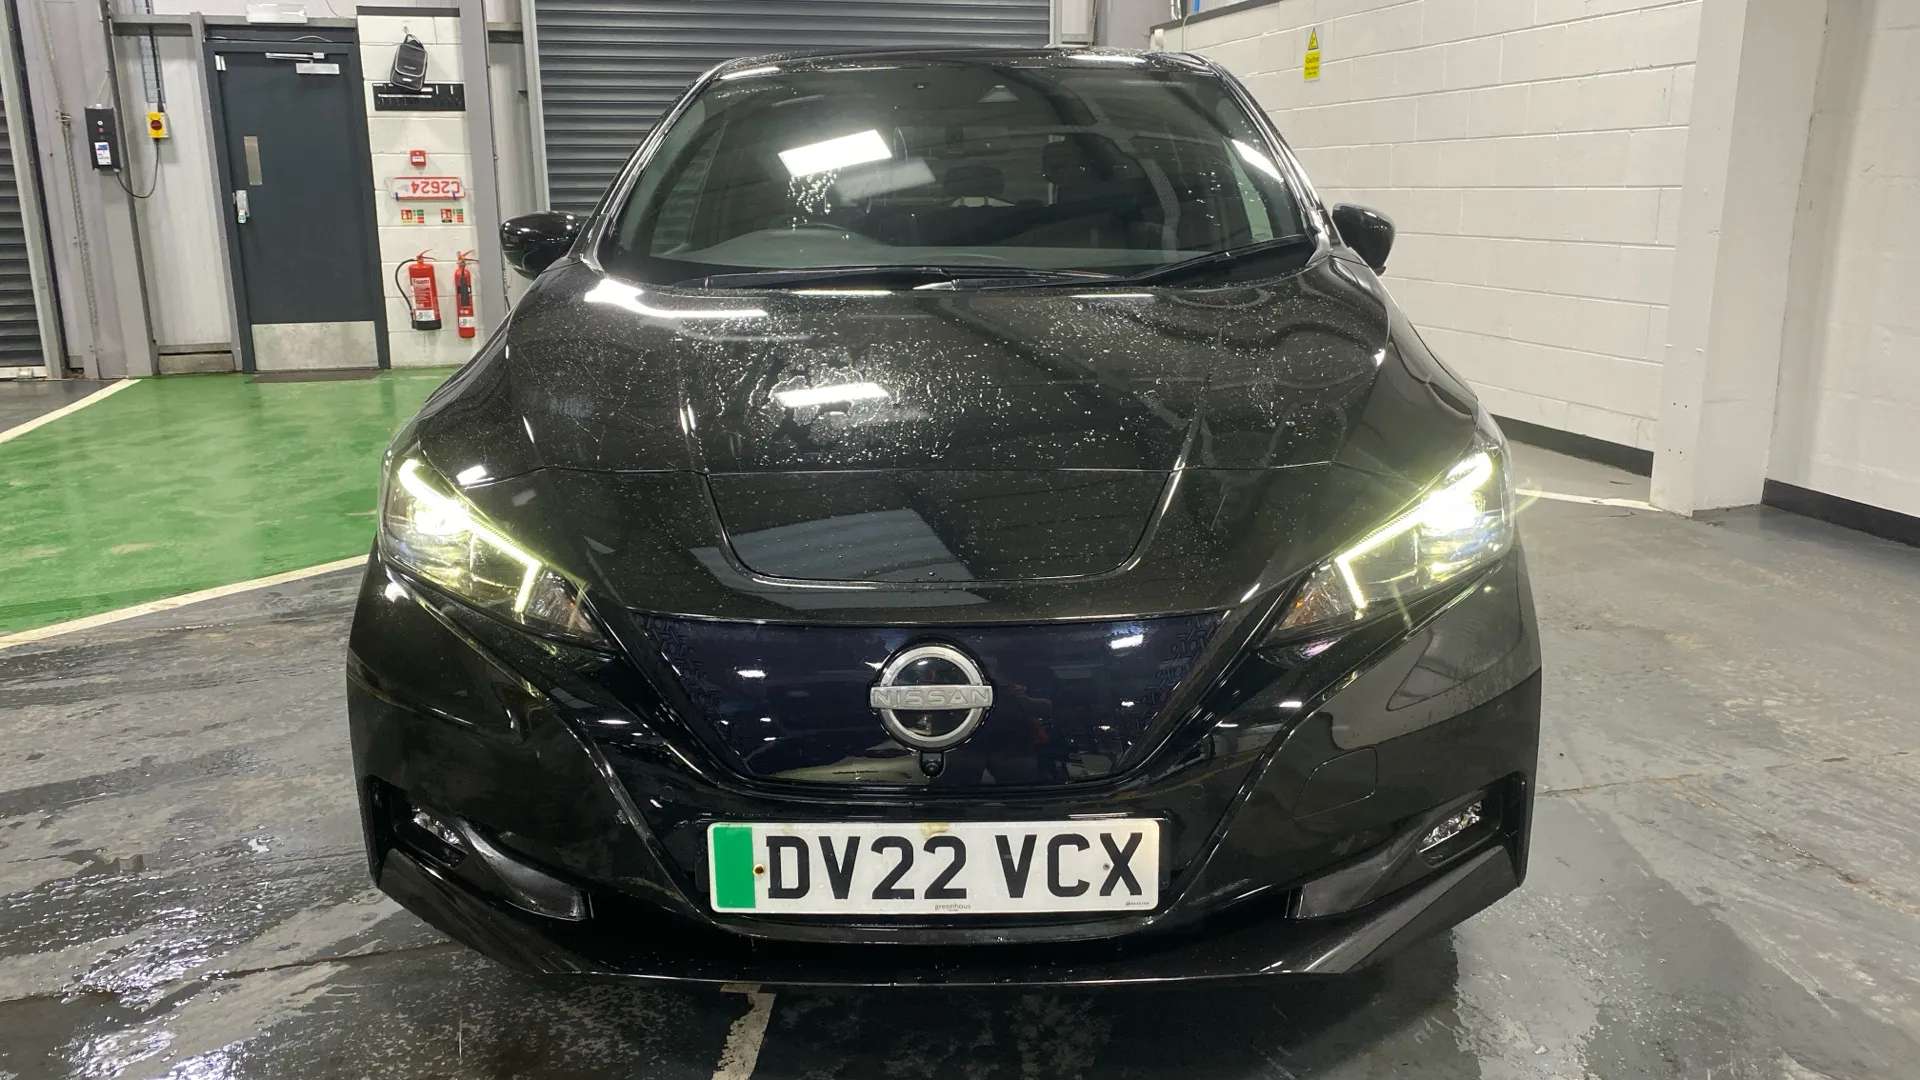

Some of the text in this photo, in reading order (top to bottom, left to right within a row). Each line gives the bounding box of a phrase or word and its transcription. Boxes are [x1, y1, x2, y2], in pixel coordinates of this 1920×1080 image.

[411, 181, 460, 194] C2624
[873, 689, 990, 706] NISSAN
[766, 833, 1143, 900] DV22 VCX
